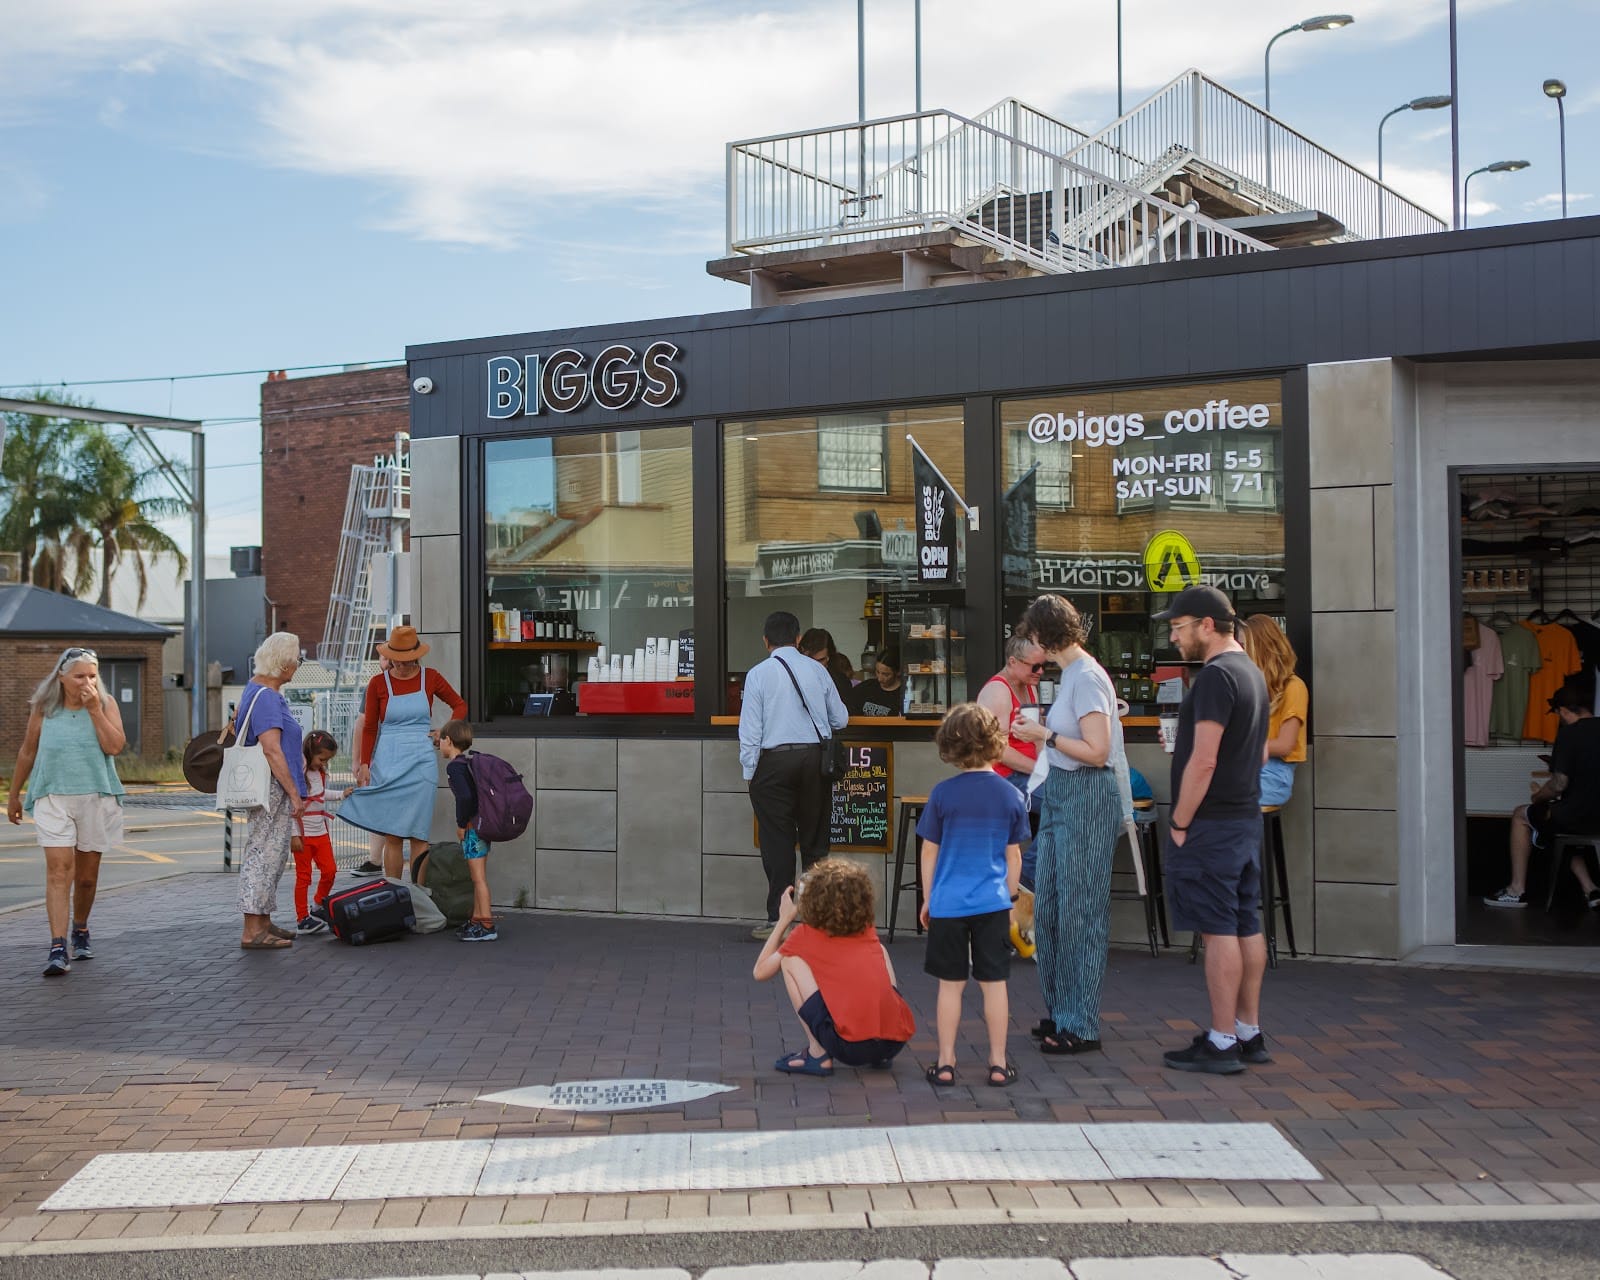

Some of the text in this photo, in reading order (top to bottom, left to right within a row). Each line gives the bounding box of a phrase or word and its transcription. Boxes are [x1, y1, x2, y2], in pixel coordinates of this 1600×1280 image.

[487, 341, 678, 419] BIGGS
[1027, 399, 1270, 447] @biggs_coffee
[374, 452, 410, 469] HAM
[1112, 449, 1262, 476] MON-FRI 5-5
[1116, 473, 1262, 499] SAT-SUN 7-1
[922, 485, 934, 541] BIGGS
[921, 545, 949, 566] OPEN
[849, 746, 872, 767] LS
[553, 1082, 667, 1094] STEP OUT
[598, 1090, 667, 1098] BEFORE
[548, 1095, 667, 1106] LOOK OUT
